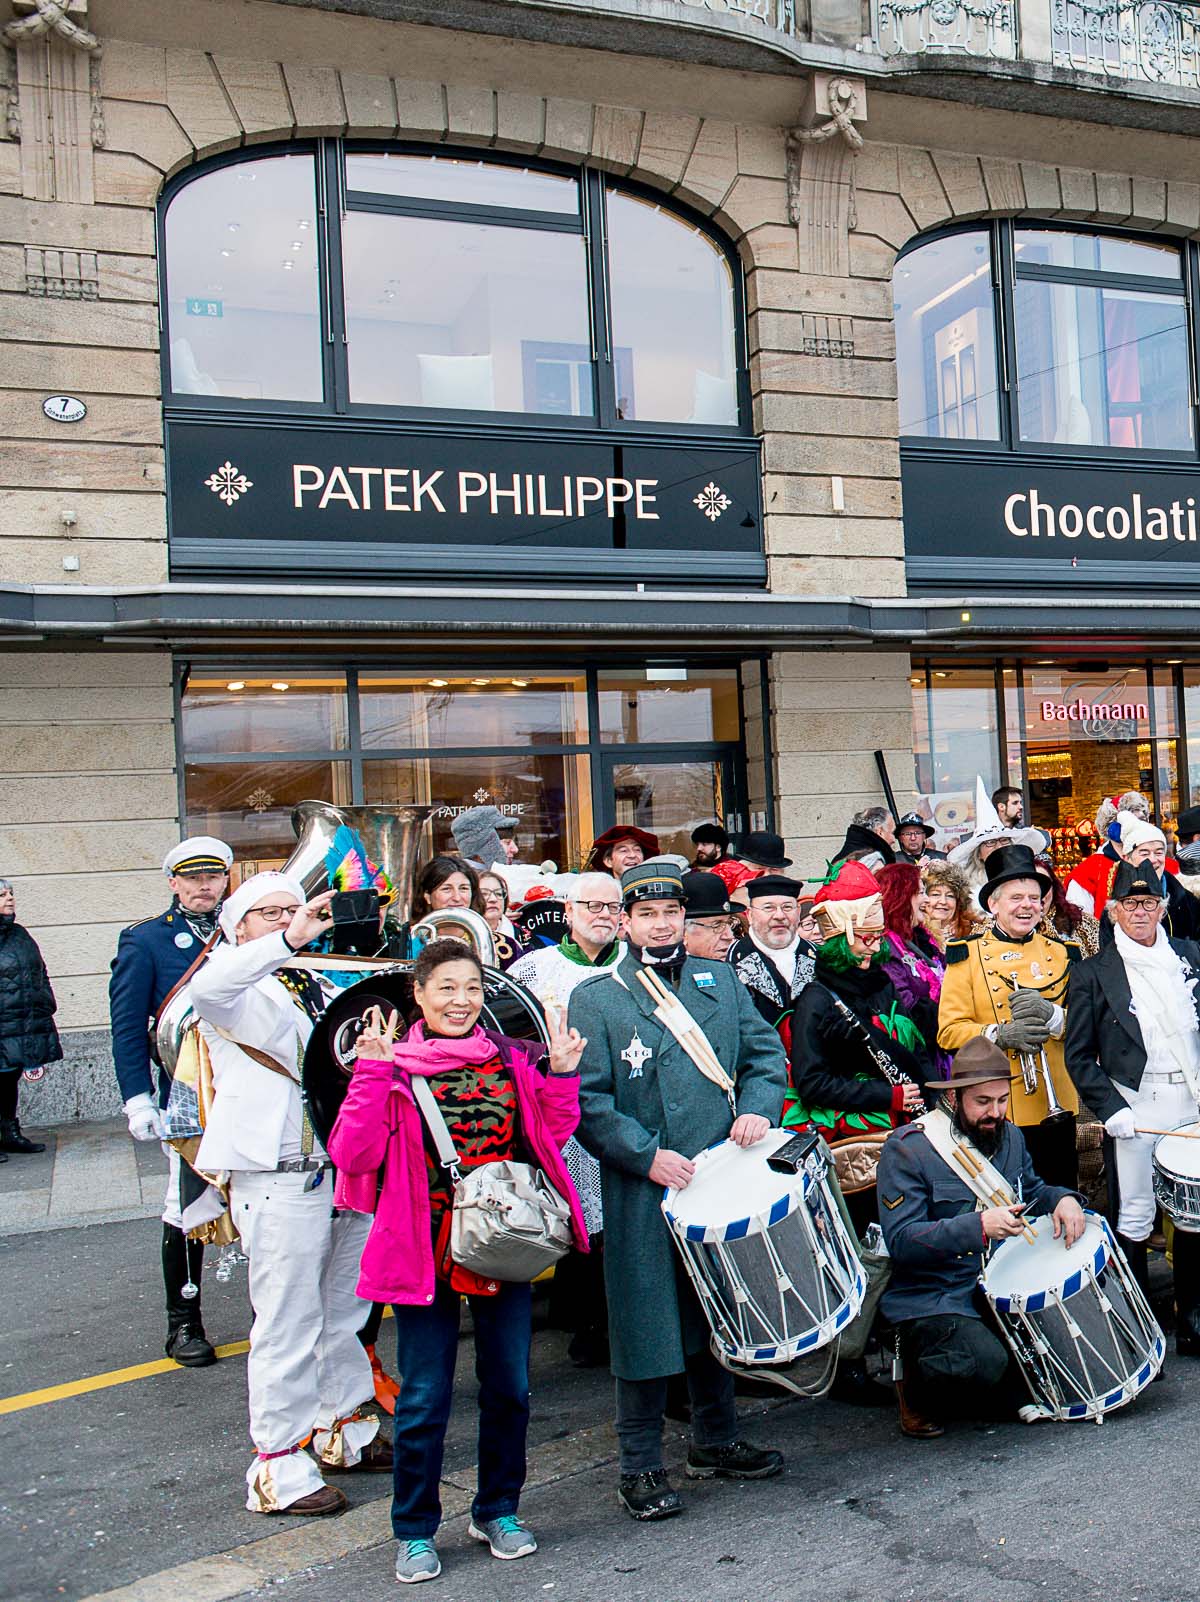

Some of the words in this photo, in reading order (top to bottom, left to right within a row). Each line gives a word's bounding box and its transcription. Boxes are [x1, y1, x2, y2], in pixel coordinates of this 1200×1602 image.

[60, 398, 69, 411] 7
[292, 464, 446, 513] PATEK
[458, 471, 661, 520] PHILIPPE
[1042, 698, 1149, 721] Bachmann
